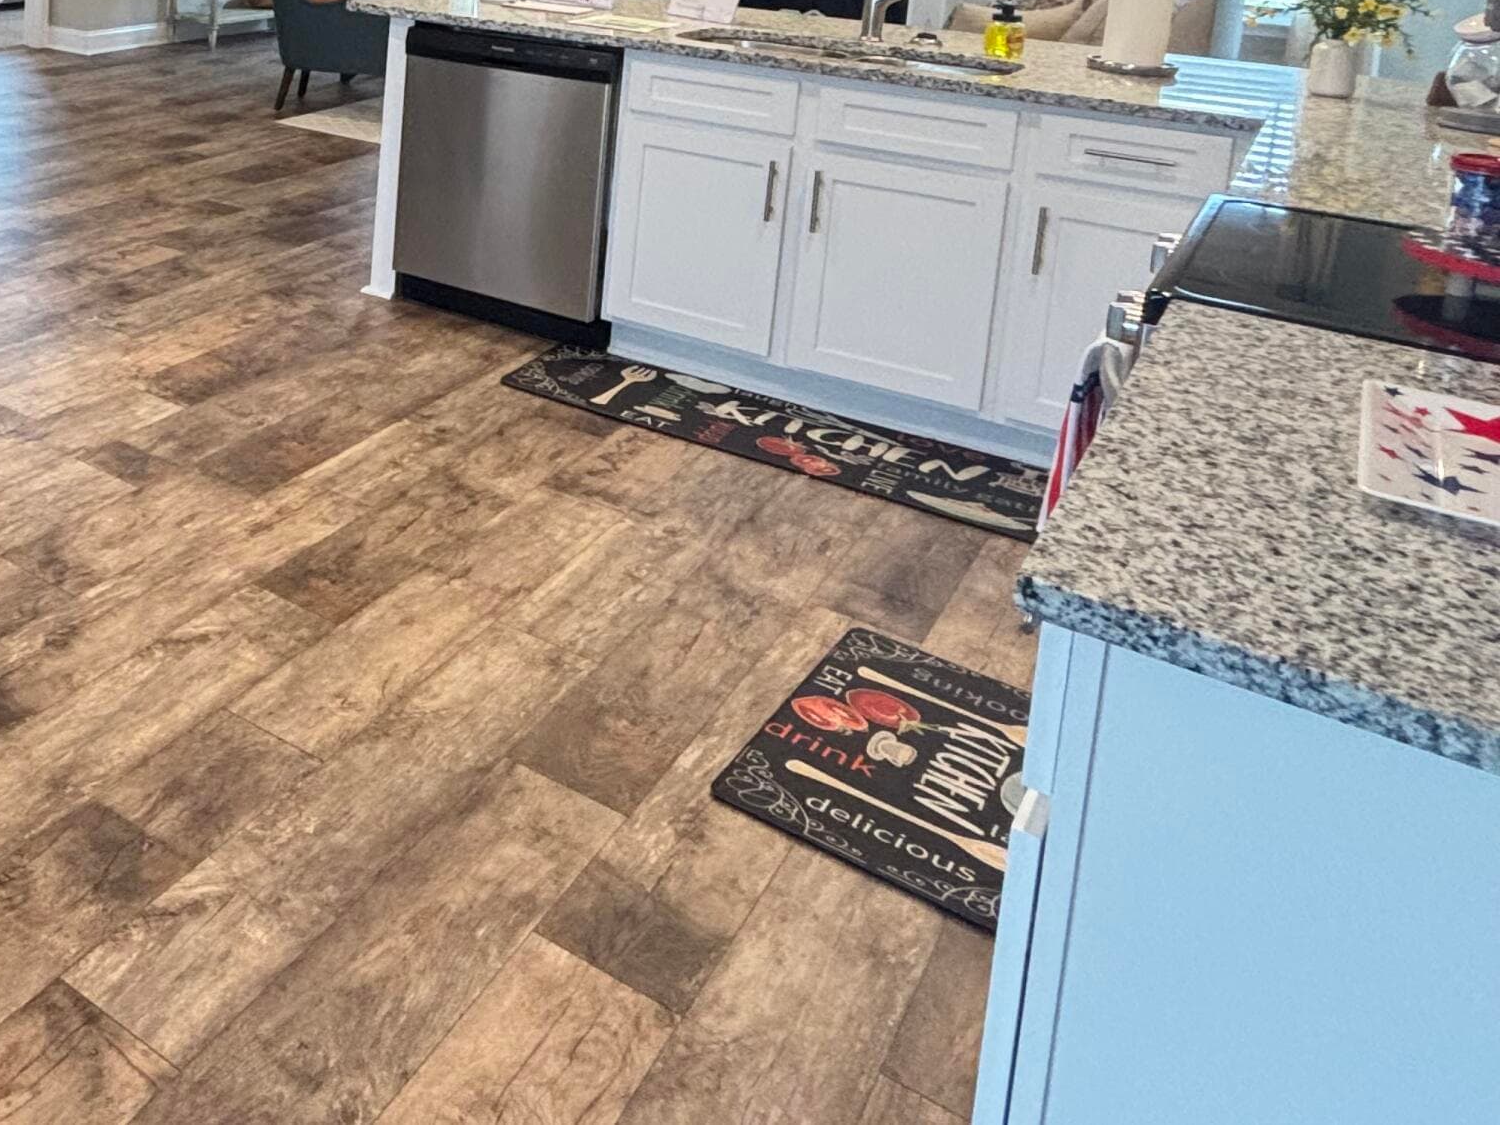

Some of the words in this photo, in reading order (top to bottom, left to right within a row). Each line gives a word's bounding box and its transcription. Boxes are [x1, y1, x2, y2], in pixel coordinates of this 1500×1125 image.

[619, 410, 673, 429] EAT
[712, 400, 991, 482] KITCHEN
[813, 664, 853, 696] EAT
[912, 666, 1030, 722] ooking
[764, 721, 877, 779] drink
[912, 721, 1020, 837] KITCHEN
[804, 796, 976, 883] delicious
